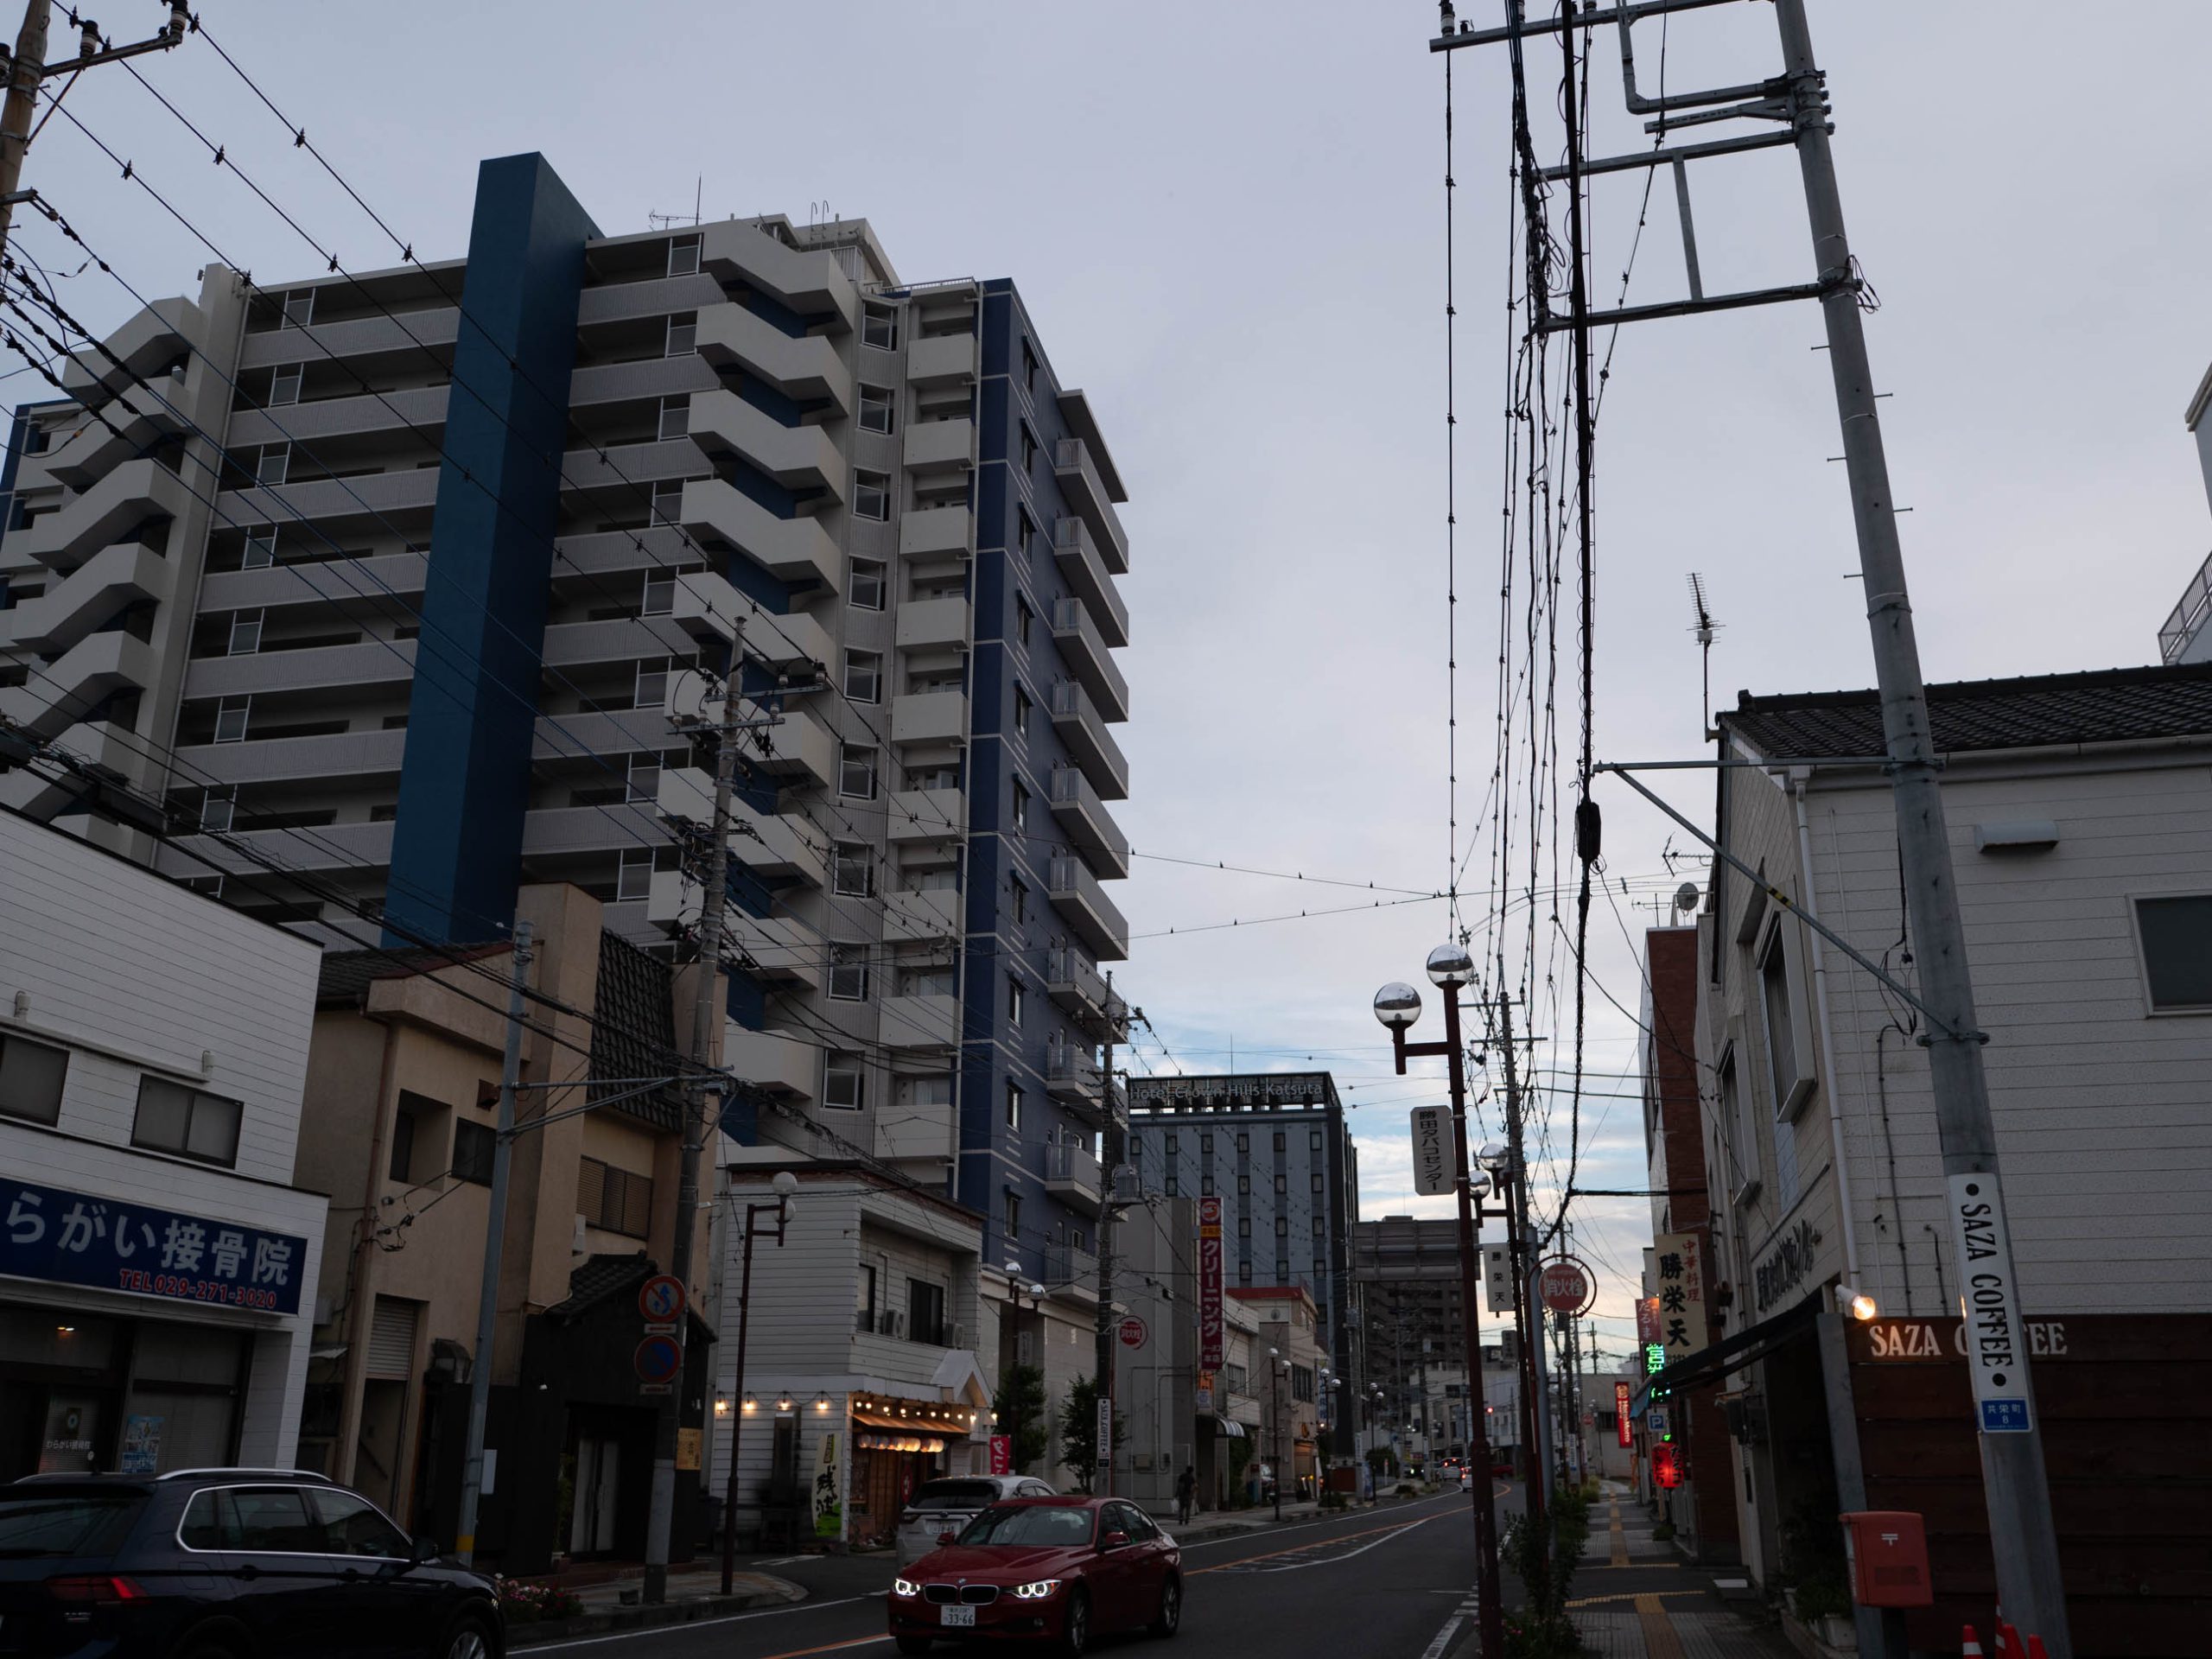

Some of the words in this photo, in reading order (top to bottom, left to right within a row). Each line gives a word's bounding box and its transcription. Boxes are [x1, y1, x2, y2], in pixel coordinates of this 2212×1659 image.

[1129, 1087, 1170, 1101] Hotel
[1175, 1086, 1225, 1099] Crown
[1226, 1084, 1261, 1097] Hills
[1267, 1082, 1323, 1096] Katsuta
[1960, 1203, 1998, 1262] SAZA
[1203, 1239, 1220, 1338] クリーニング
[1545, 1281, 1584, 1297] 消火栓
[1658, 1252, 1691, 1347] 勝栄天
[1868, 1325, 1943, 1357] SAZA
[1970, 1274, 2014, 1367] COFFEE
